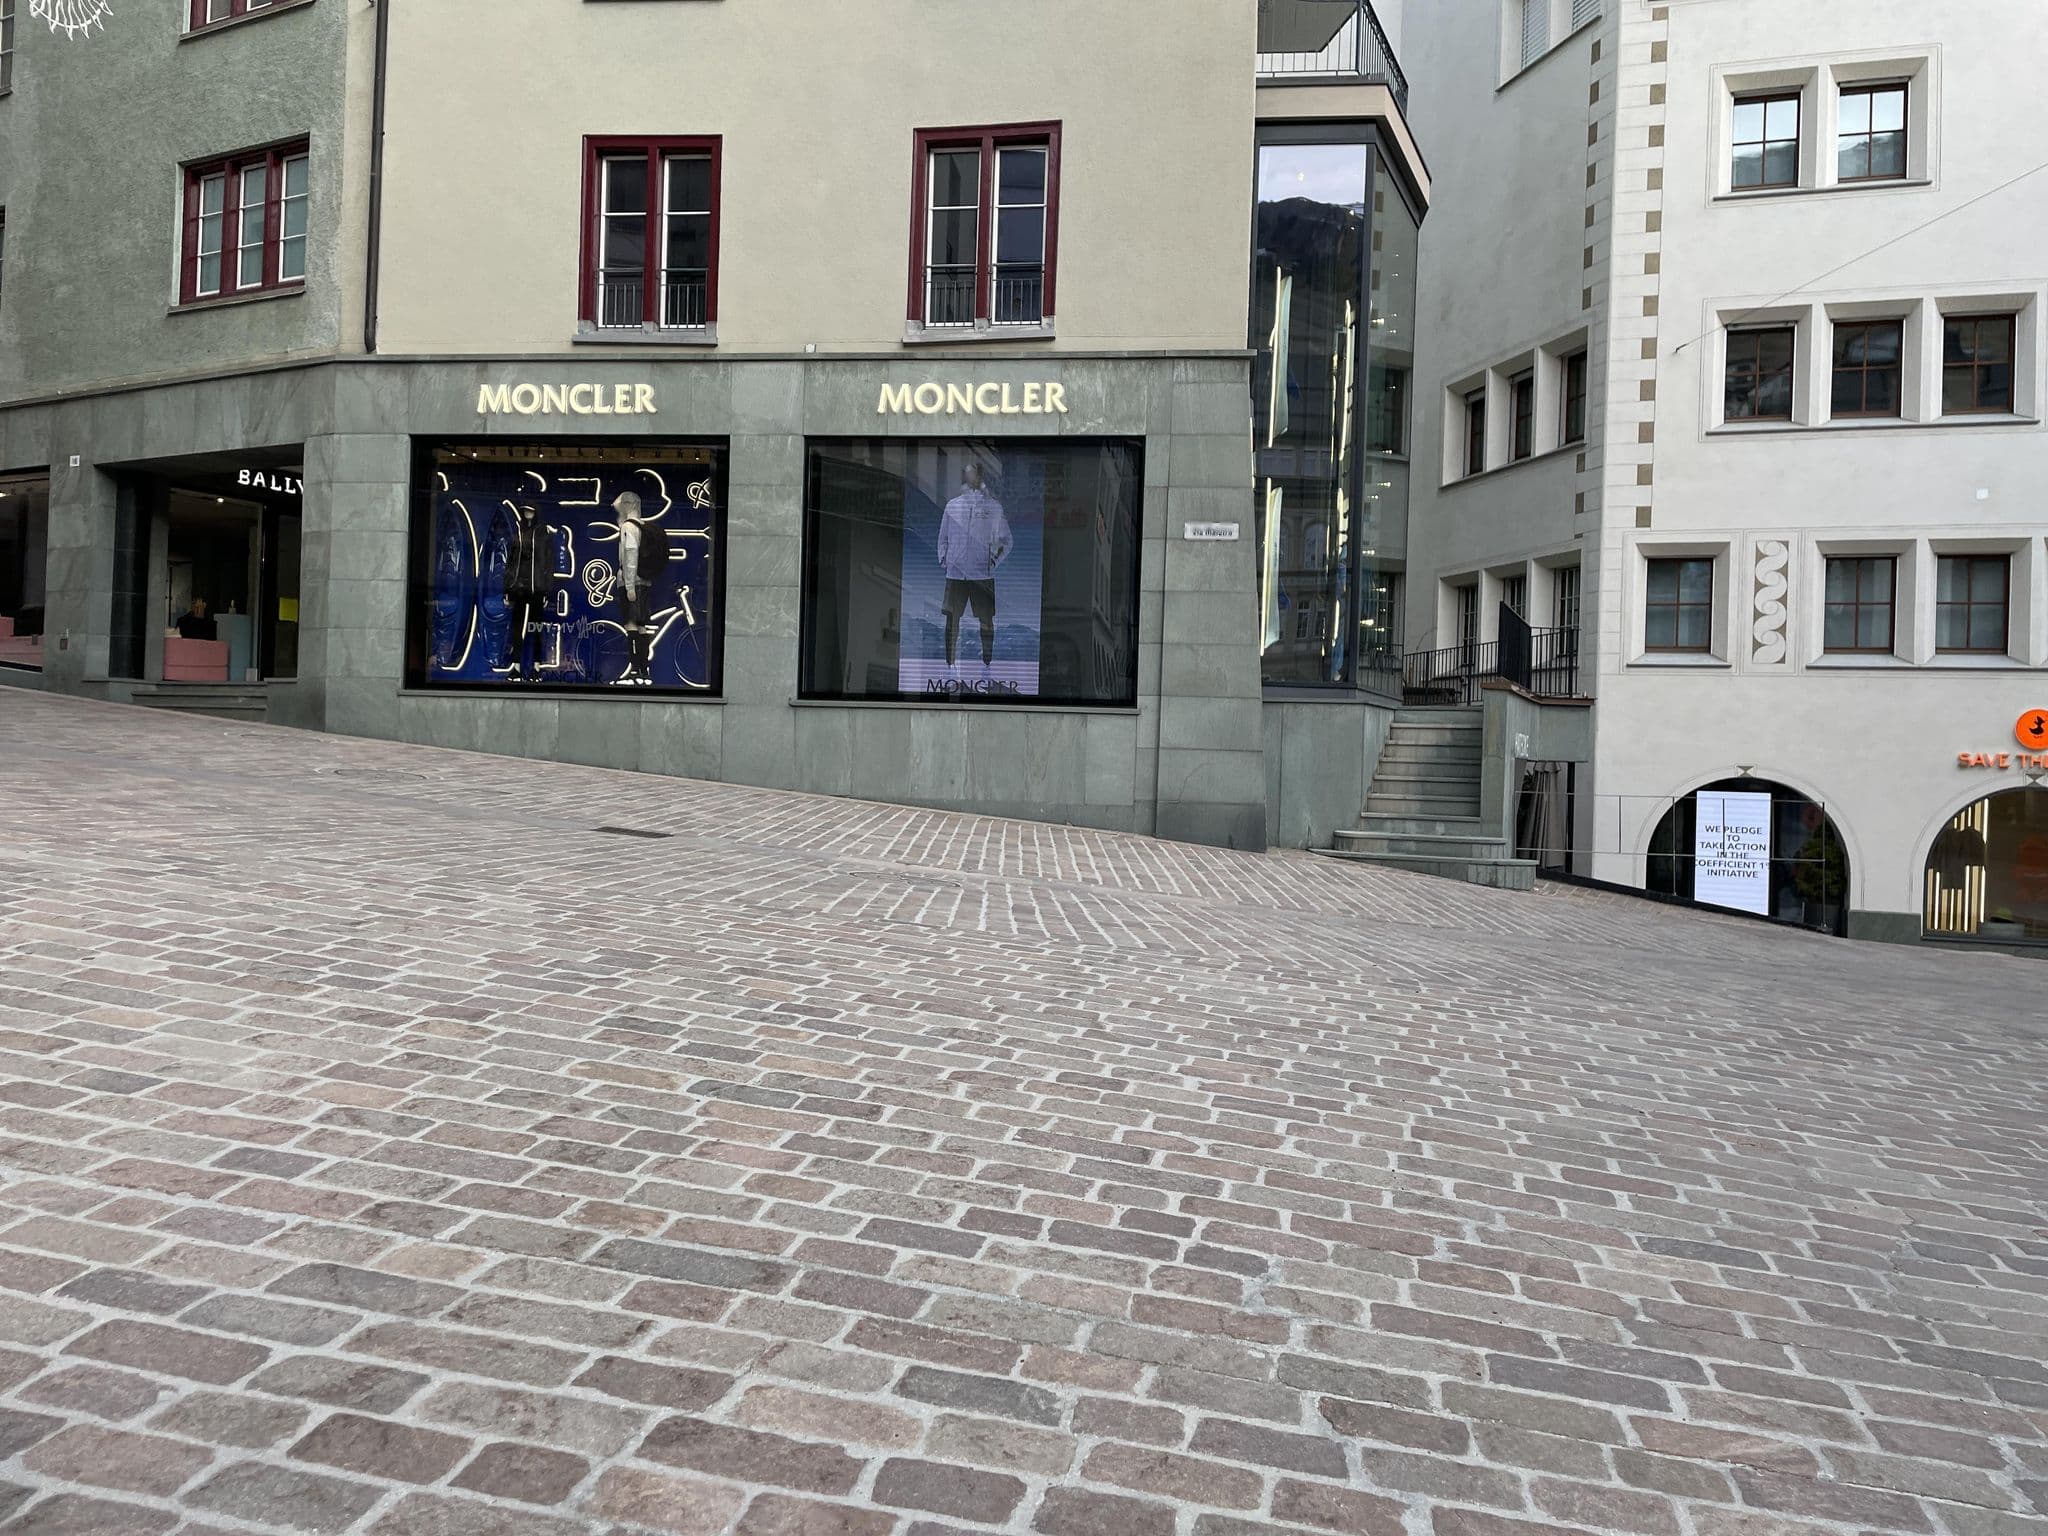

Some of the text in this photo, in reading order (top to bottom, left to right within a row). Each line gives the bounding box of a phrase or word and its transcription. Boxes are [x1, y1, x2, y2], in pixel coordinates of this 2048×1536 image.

[476, 383, 658, 415] MONCLER
[876, 382, 1070, 415] MONCLER
[1958, 751, 2012, 769] SAVE
[1705, 825, 1762, 835] WE PLEDGE
[1727, 834, 1740, 842] TO
[1728, 843, 1766, 851] ACTION
[1707, 869, 1759, 878] INITIATIVE
